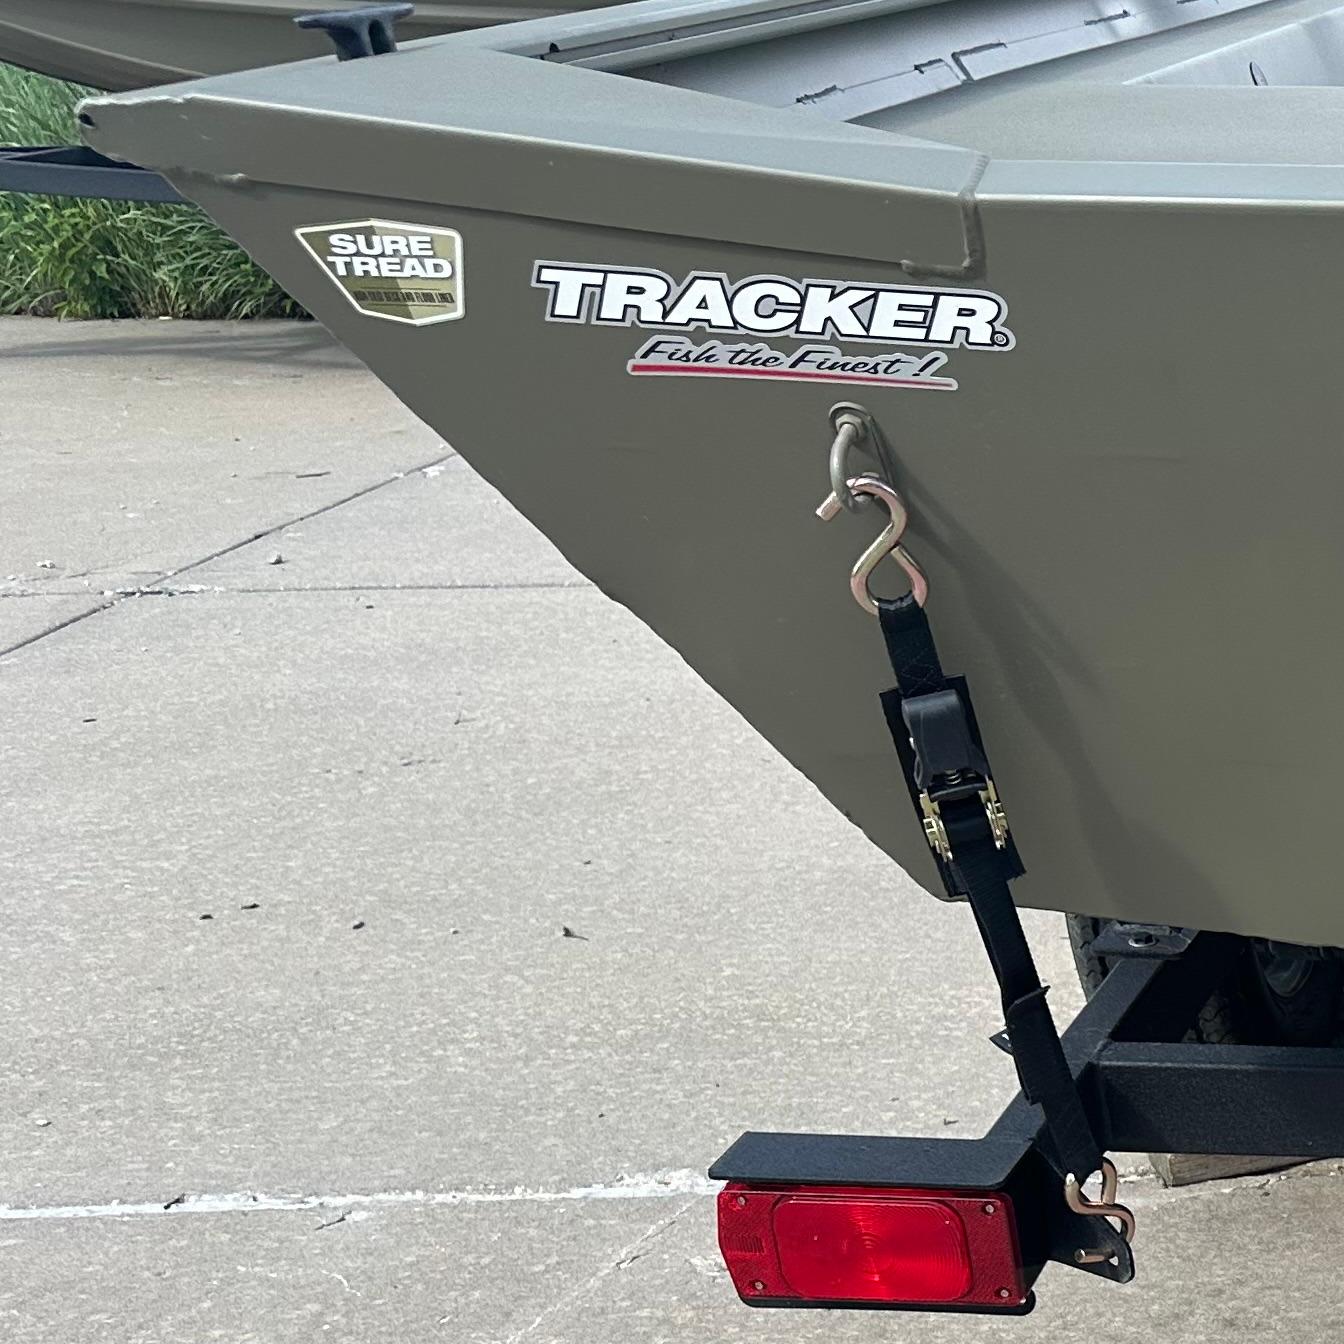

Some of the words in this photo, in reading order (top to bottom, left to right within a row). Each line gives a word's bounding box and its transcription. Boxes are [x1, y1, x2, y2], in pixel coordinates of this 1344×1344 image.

[328, 233, 433, 256] SURE
[327, 256, 453, 278] TREAD
[537, 264, 1007, 345] TRACKER
[640, 340, 719, 365] Fish
[725, 345, 779, 370] the
[789, 349, 908, 377] Finest
